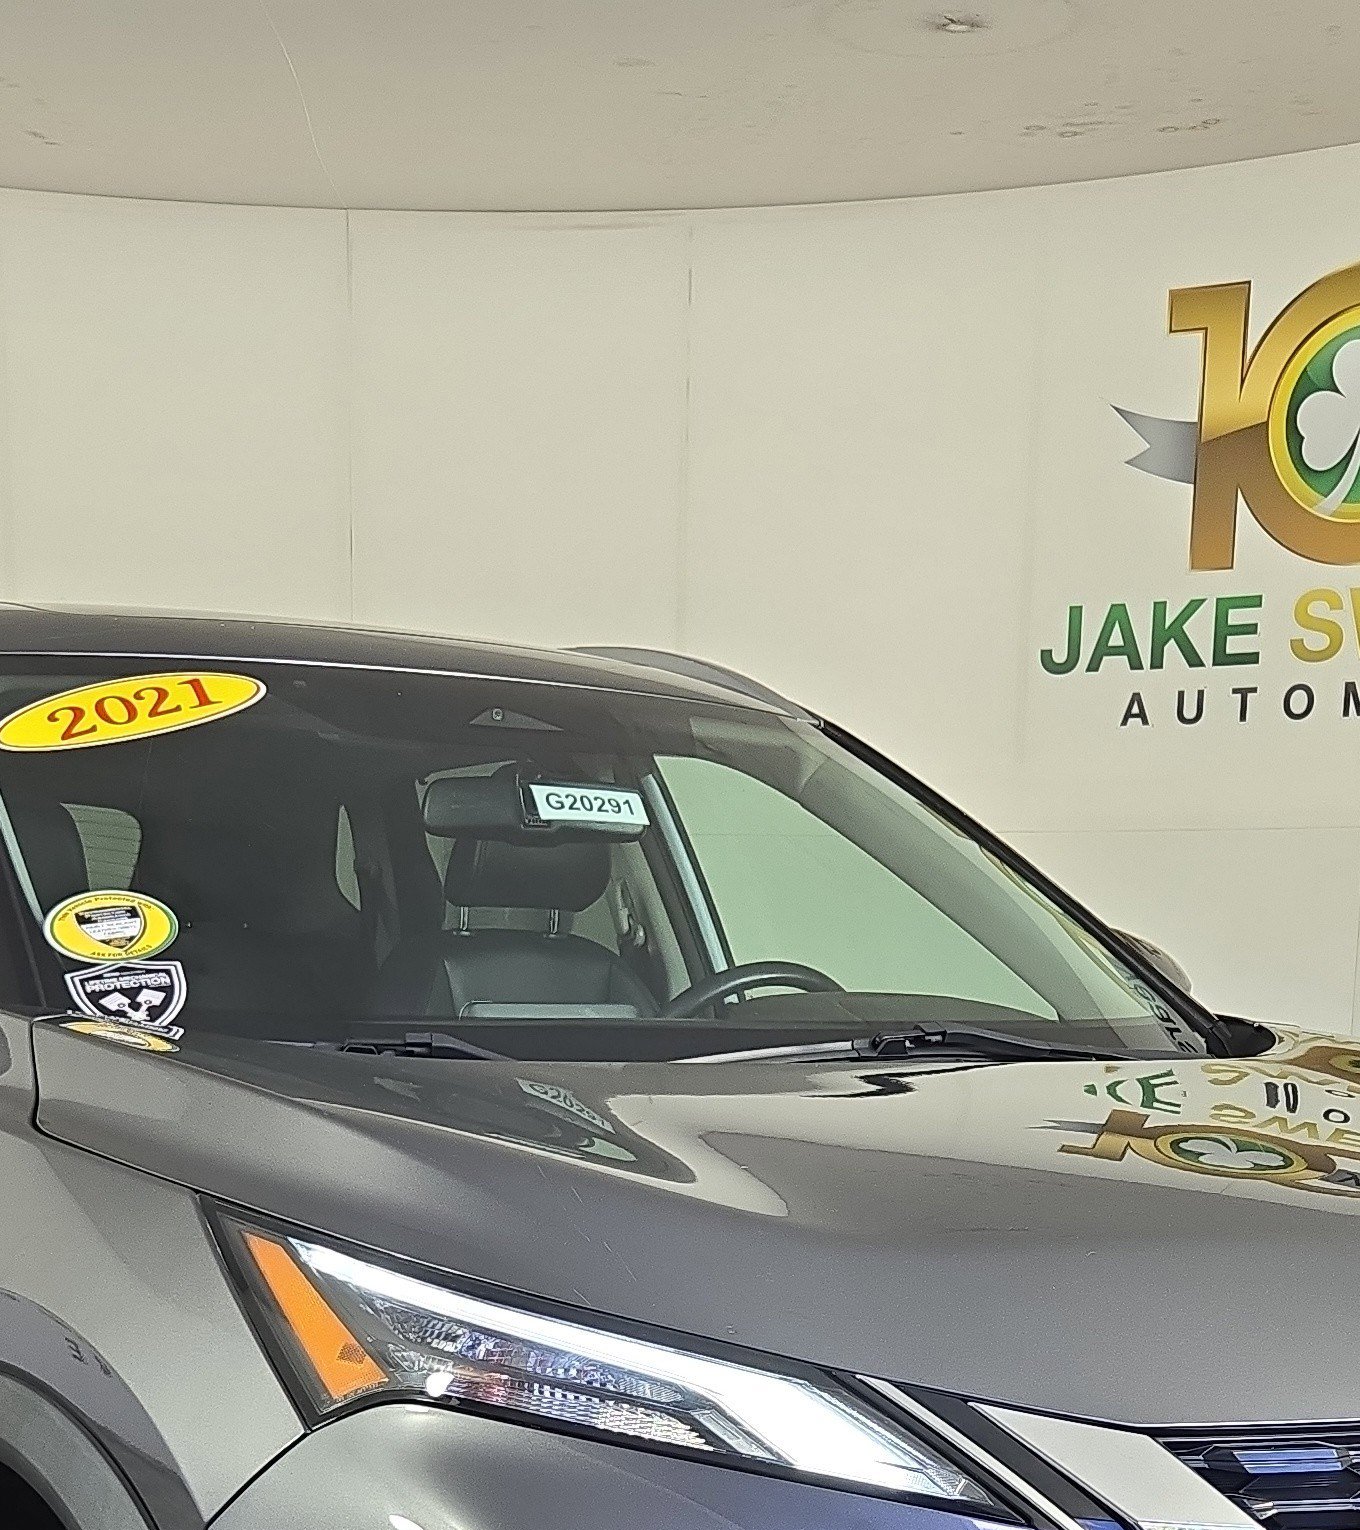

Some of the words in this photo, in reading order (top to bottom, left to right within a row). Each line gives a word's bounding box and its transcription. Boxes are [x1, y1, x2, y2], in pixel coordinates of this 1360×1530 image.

[1040, 594, 1263, 674] JAKE
[47, 678, 223, 743] 2021
[546, 792, 634, 816] G20291
[84, 977, 171, 993] PROTECTION
